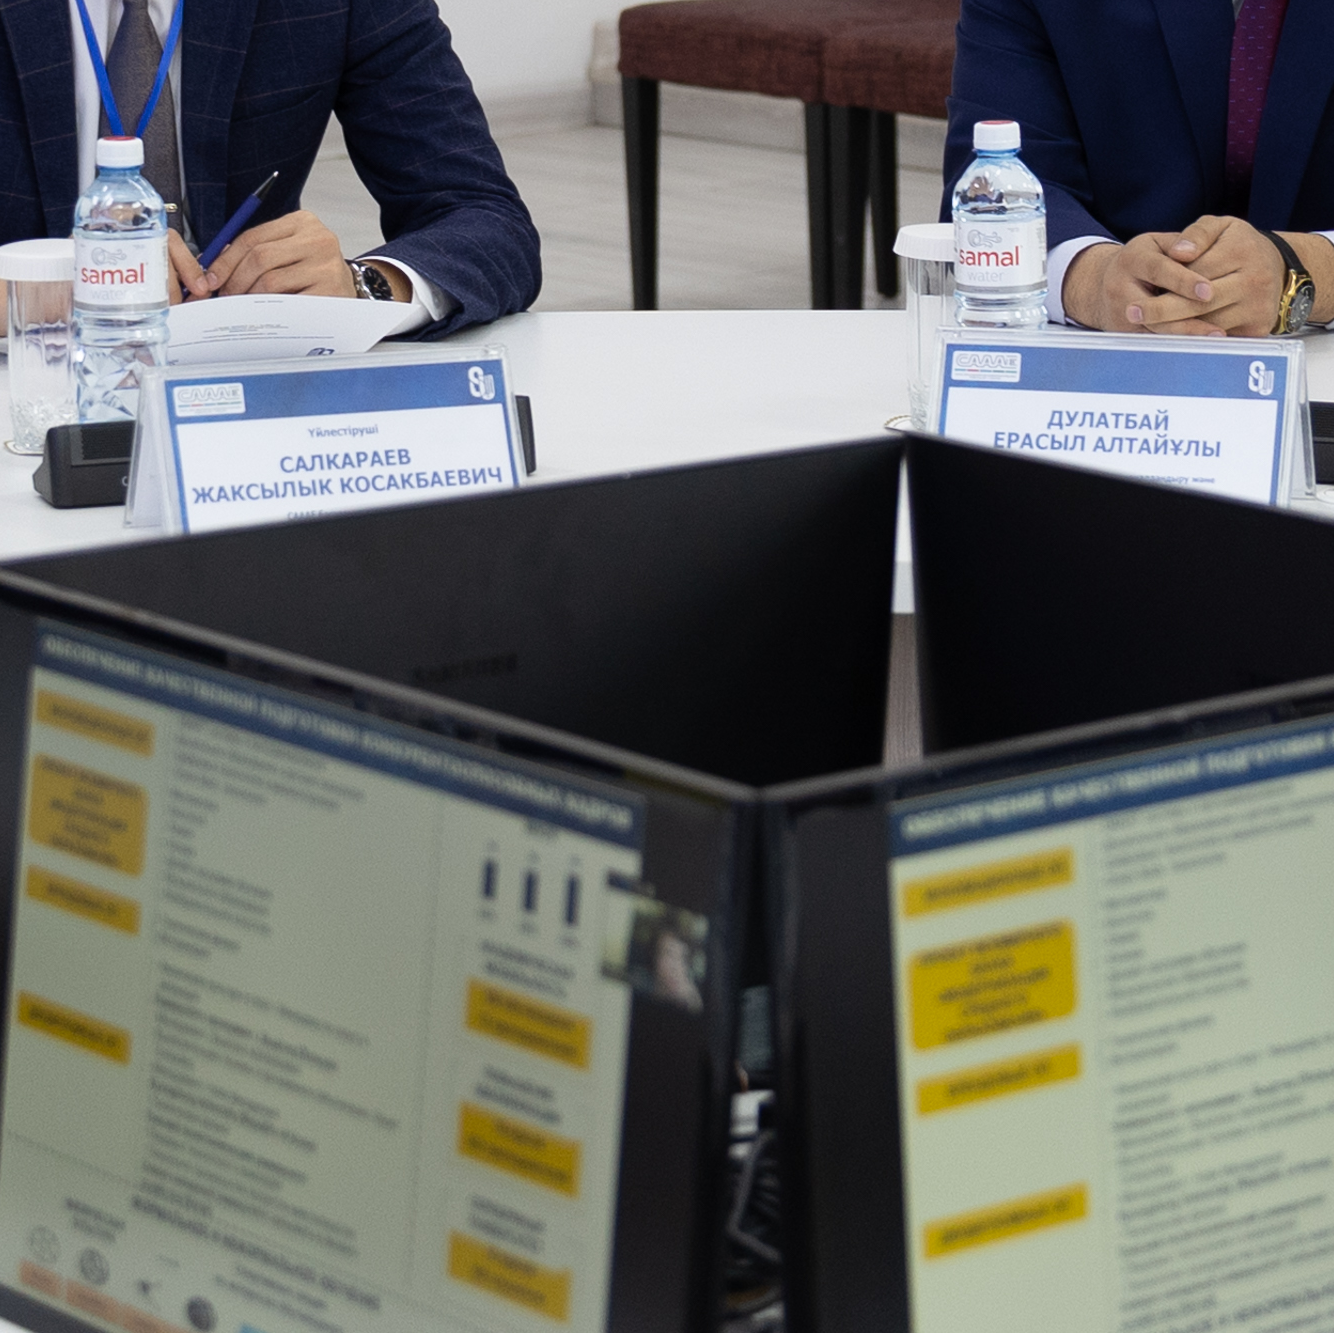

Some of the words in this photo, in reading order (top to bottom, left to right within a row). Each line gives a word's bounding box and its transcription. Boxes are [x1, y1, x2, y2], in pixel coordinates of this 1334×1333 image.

[959, 246, 1020, 267] samal
[81, 263, 145, 284] samal
[968, 269, 1004, 283] water
[1046, 408, 1169, 431] ДУЛАТБАЙ
[308, 424, 379, 439] Үйлестіруші
[993, 431, 1086, 452] ЕРАСЫЛ
[1092, 434, 1222, 458] АЛТАЙҰЛЫ
[279, 448, 411, 474] САЛКАРАЕВ
[193, 471, 334, 504] ЖАКСЫЛЫК
[341, 467, 503, 494] КОСАКБАЕВИЧ
